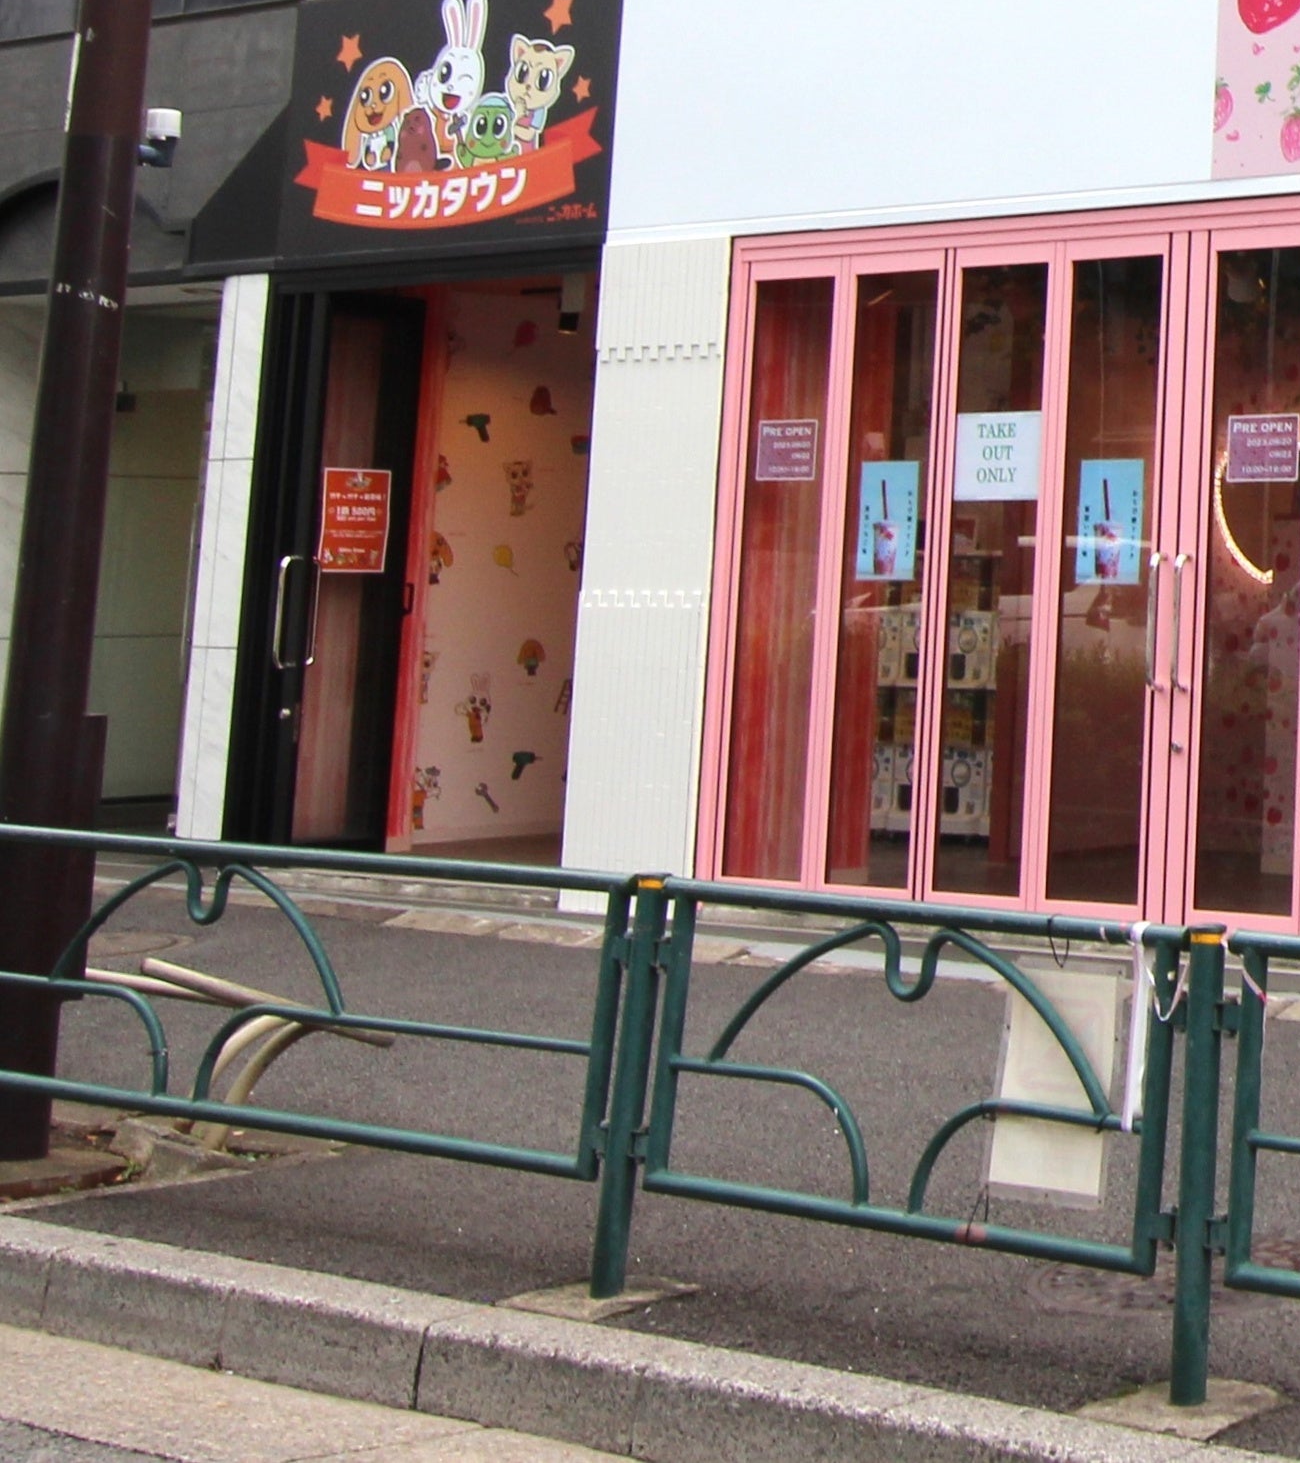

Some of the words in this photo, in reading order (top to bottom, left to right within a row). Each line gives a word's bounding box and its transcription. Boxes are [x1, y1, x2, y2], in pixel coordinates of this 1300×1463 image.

[355, 167, 527, 219] ニッカタウン
[977, 422, 1017, 439] TAKE
[1233, 422, 1258, 433] PRE
[1260, 422, 1293, 433] OPEN
[982, 445, 1014, 461] OUT
[976, 467, 1017, 484] ONLY
